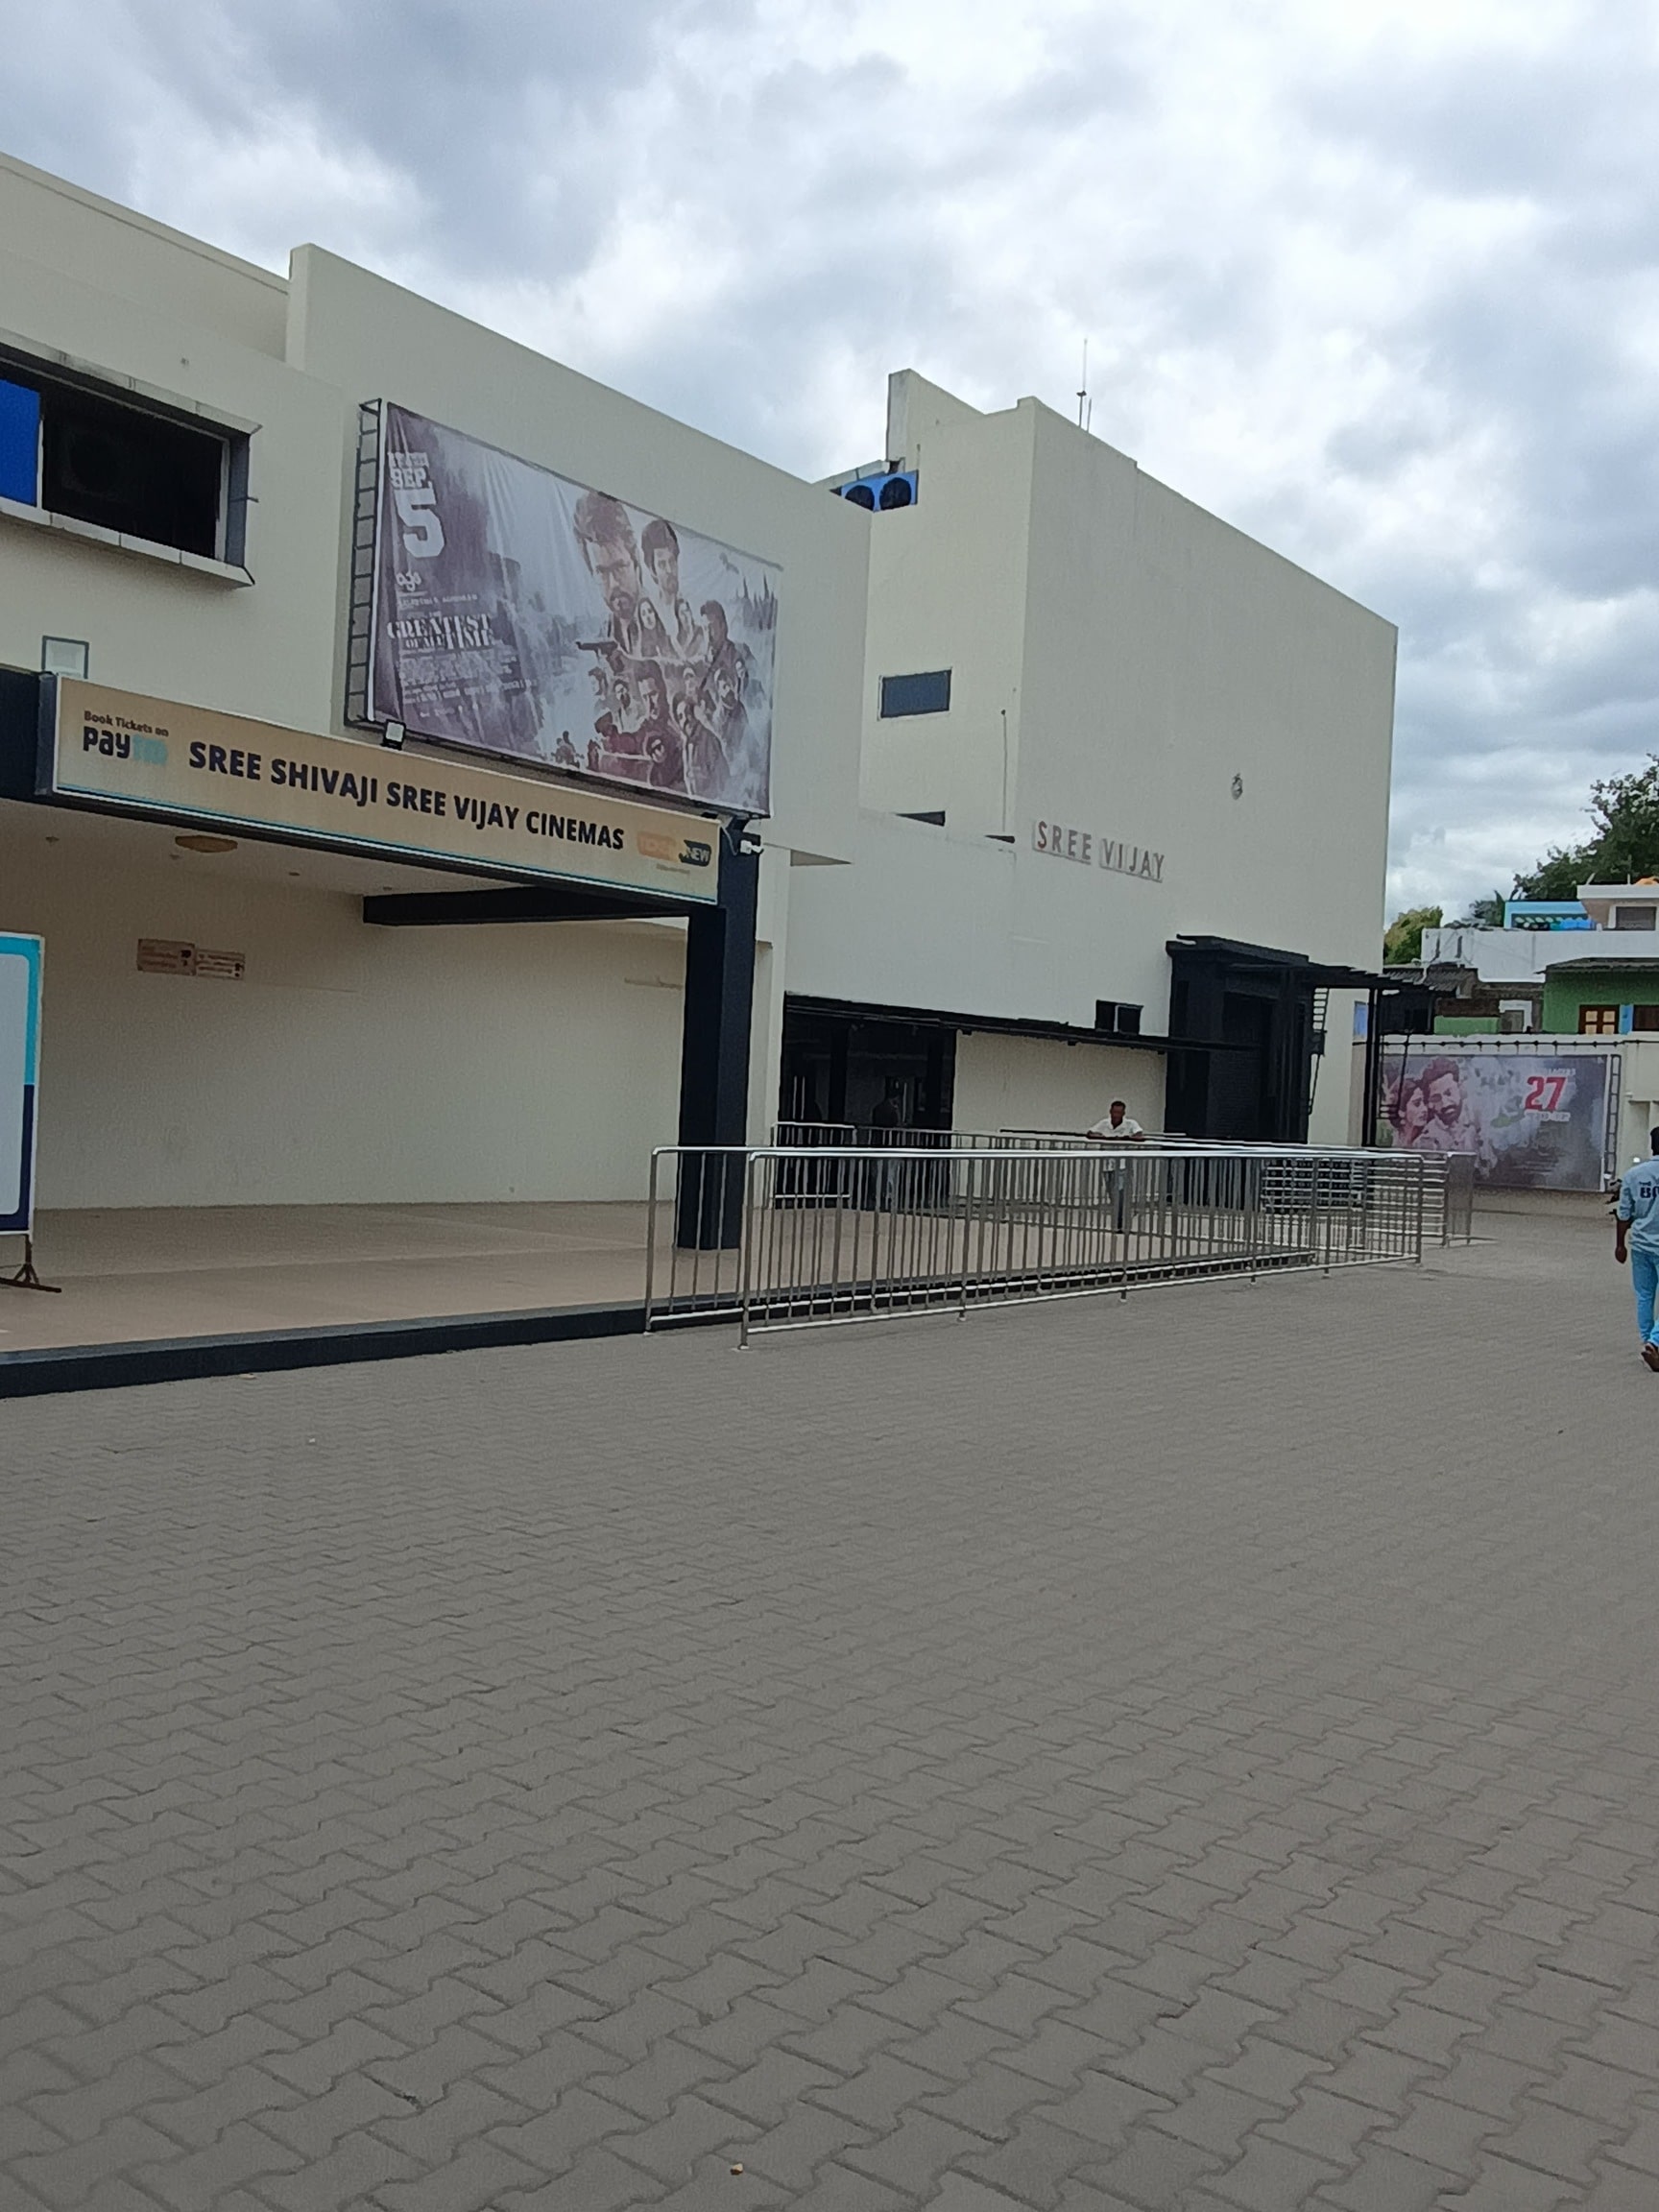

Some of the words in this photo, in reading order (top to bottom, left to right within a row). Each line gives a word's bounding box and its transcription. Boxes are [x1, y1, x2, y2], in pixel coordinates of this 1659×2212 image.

[394, 487, 445, 558] 5
[84, 709, 113, 727] Book
[115, 716, 153, 734] Tickets
[155, 727, 169, 738] on
[189, 741, 261, 781] SREE
[271, 757, 378, 807] SHIVAJI
[387, 781, 446, 817] SREE
[454, 795, 520, 830] VIJAY
[526, 811, 625, 851] CINEMAS
[1037, 820, 1093, 861] SREE
[1102, 837, 1165, 879] VIJAY
[1525, 1075, 1567, 1112] 27
